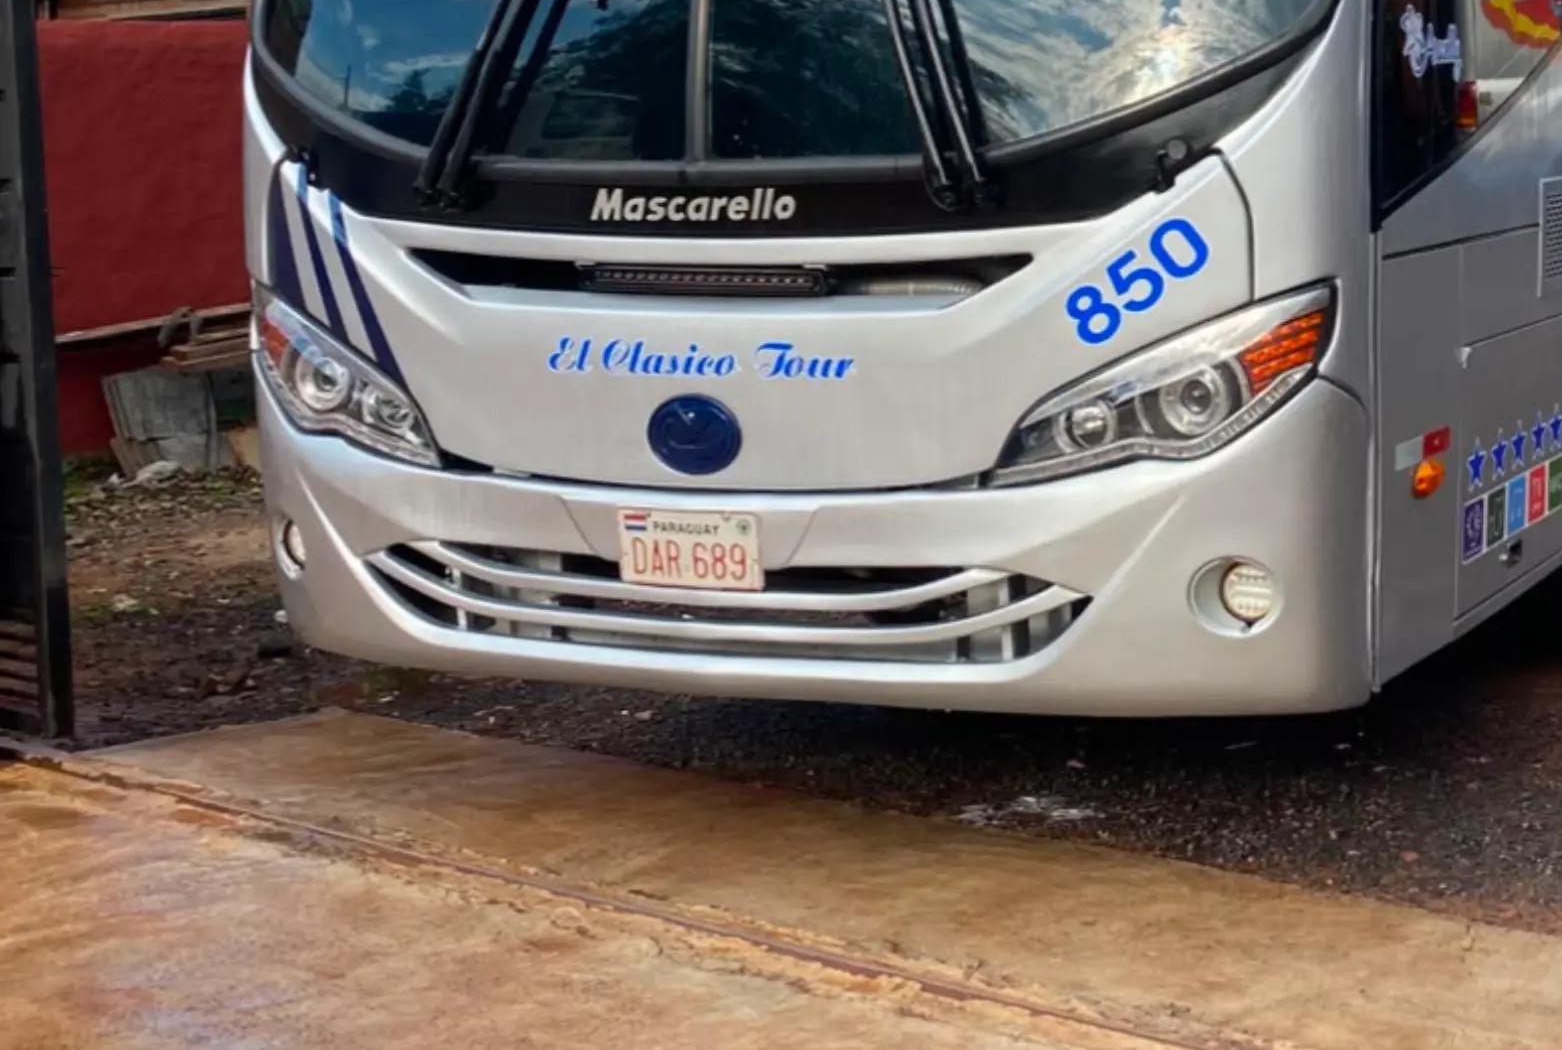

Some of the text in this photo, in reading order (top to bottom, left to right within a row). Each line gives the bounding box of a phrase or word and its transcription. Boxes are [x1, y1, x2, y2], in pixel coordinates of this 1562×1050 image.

[590, 187, 797, 221] Mascarello
[1066, 217, 1210, 345] 850
[548, 336, 855, 379] El Clasico Tour
[652, 520, 721, 536] PARAGUAY
[631, 536, 747, 581] DAR 689
